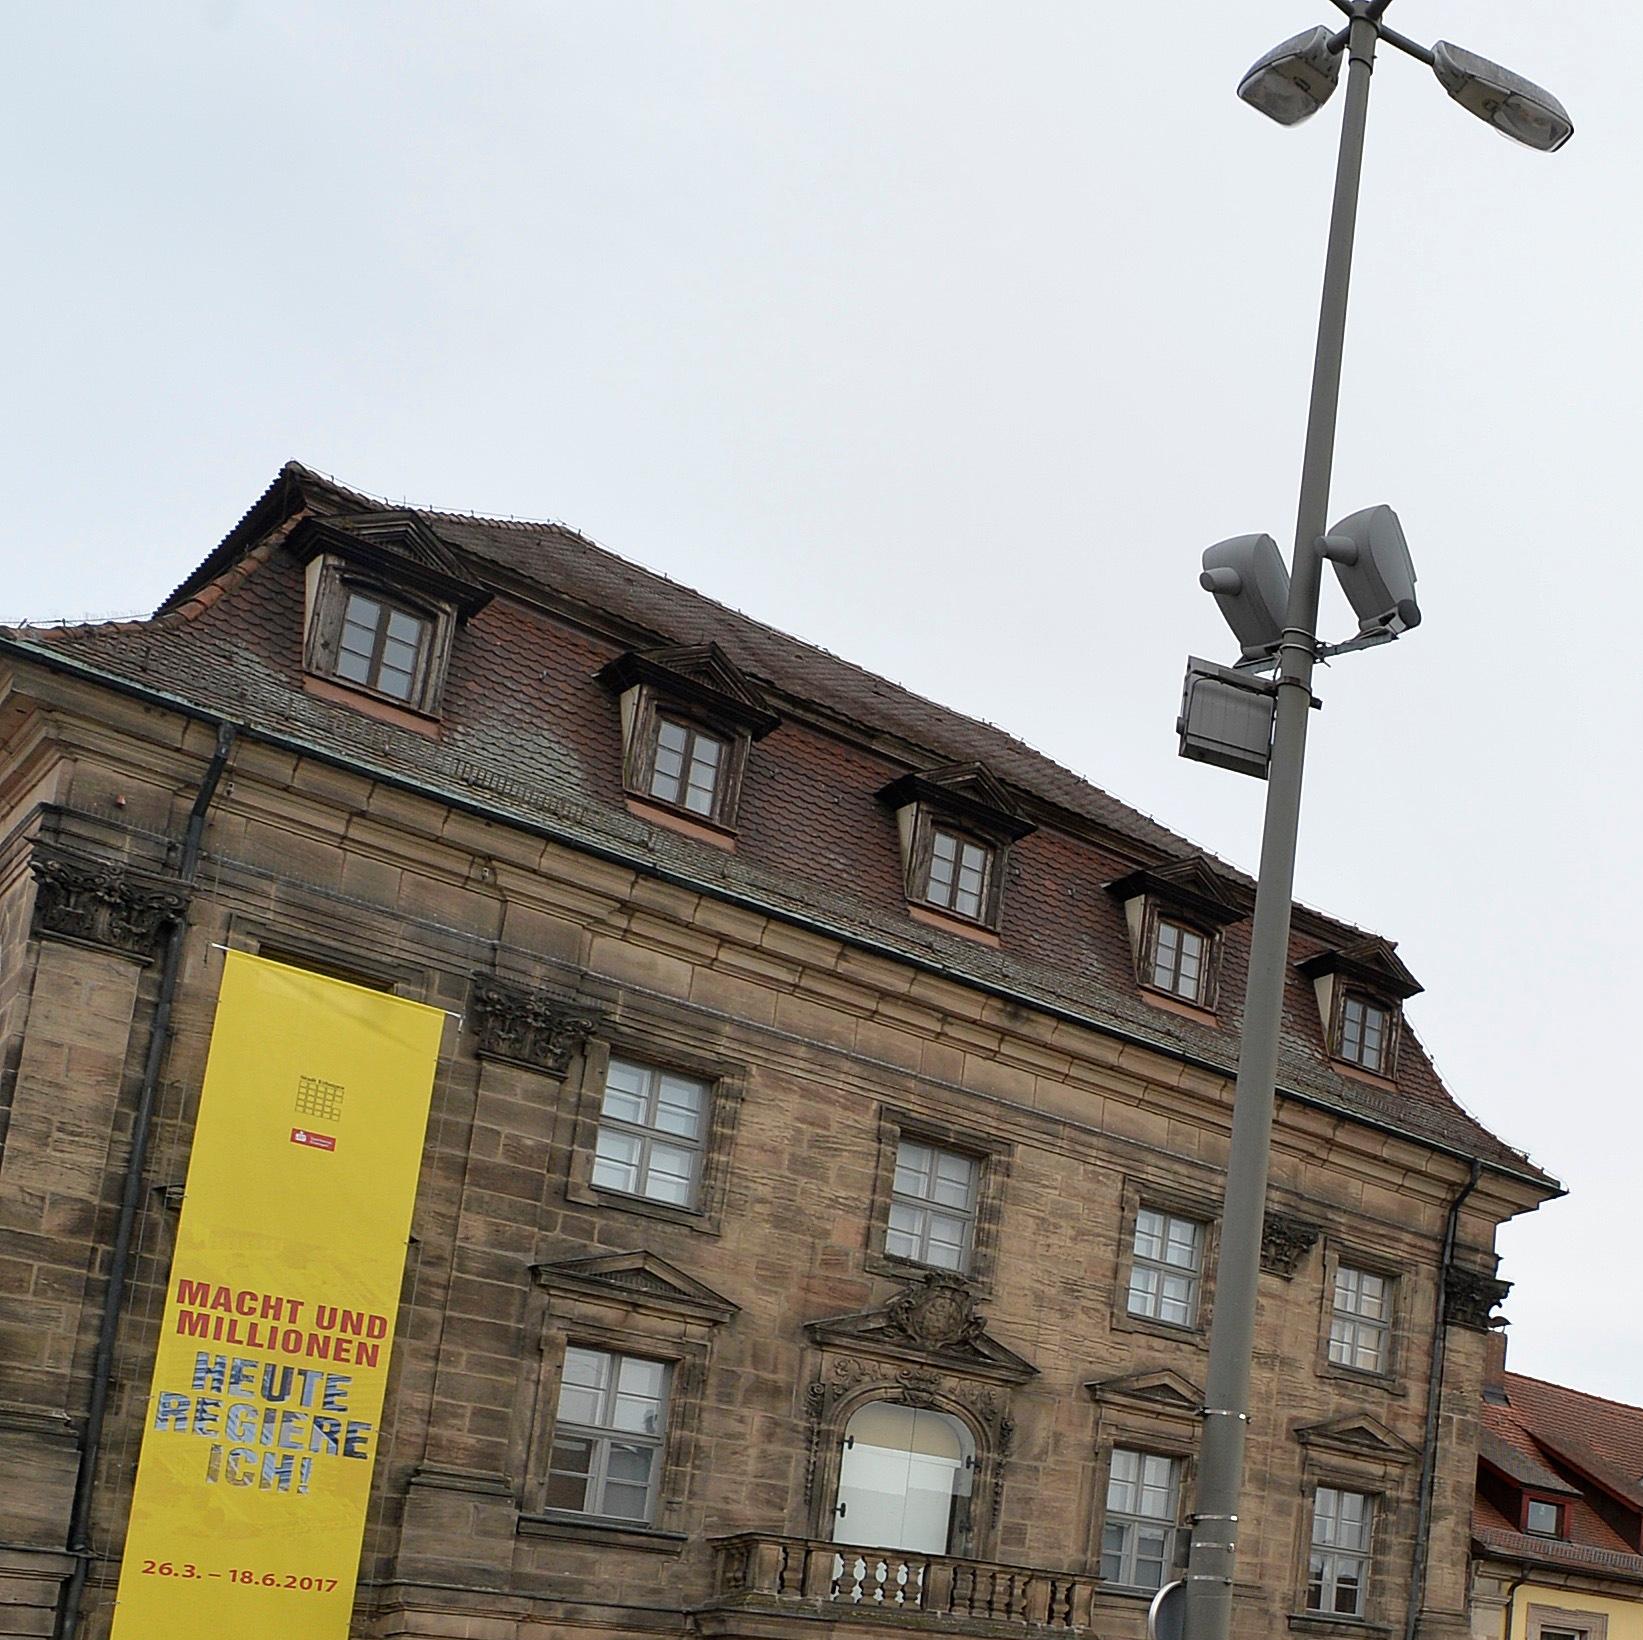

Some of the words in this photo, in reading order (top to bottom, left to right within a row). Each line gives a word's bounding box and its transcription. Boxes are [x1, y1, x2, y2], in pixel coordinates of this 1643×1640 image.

[176, 1279, 304, 1324] MACHT
[315, 1305, 388, 1340] UND
[176, 1310, 380, 1368] MILLIONEN
[191, 1351, 352, 1412] HEUTE
[154, 1391, 373, 1460] REGIERE
[205, 1444, 312, 1494] ICH!
[141, 1560, 202, 1579] 26.3.
[229, 1569, 338, 1593] 18.6.2017
